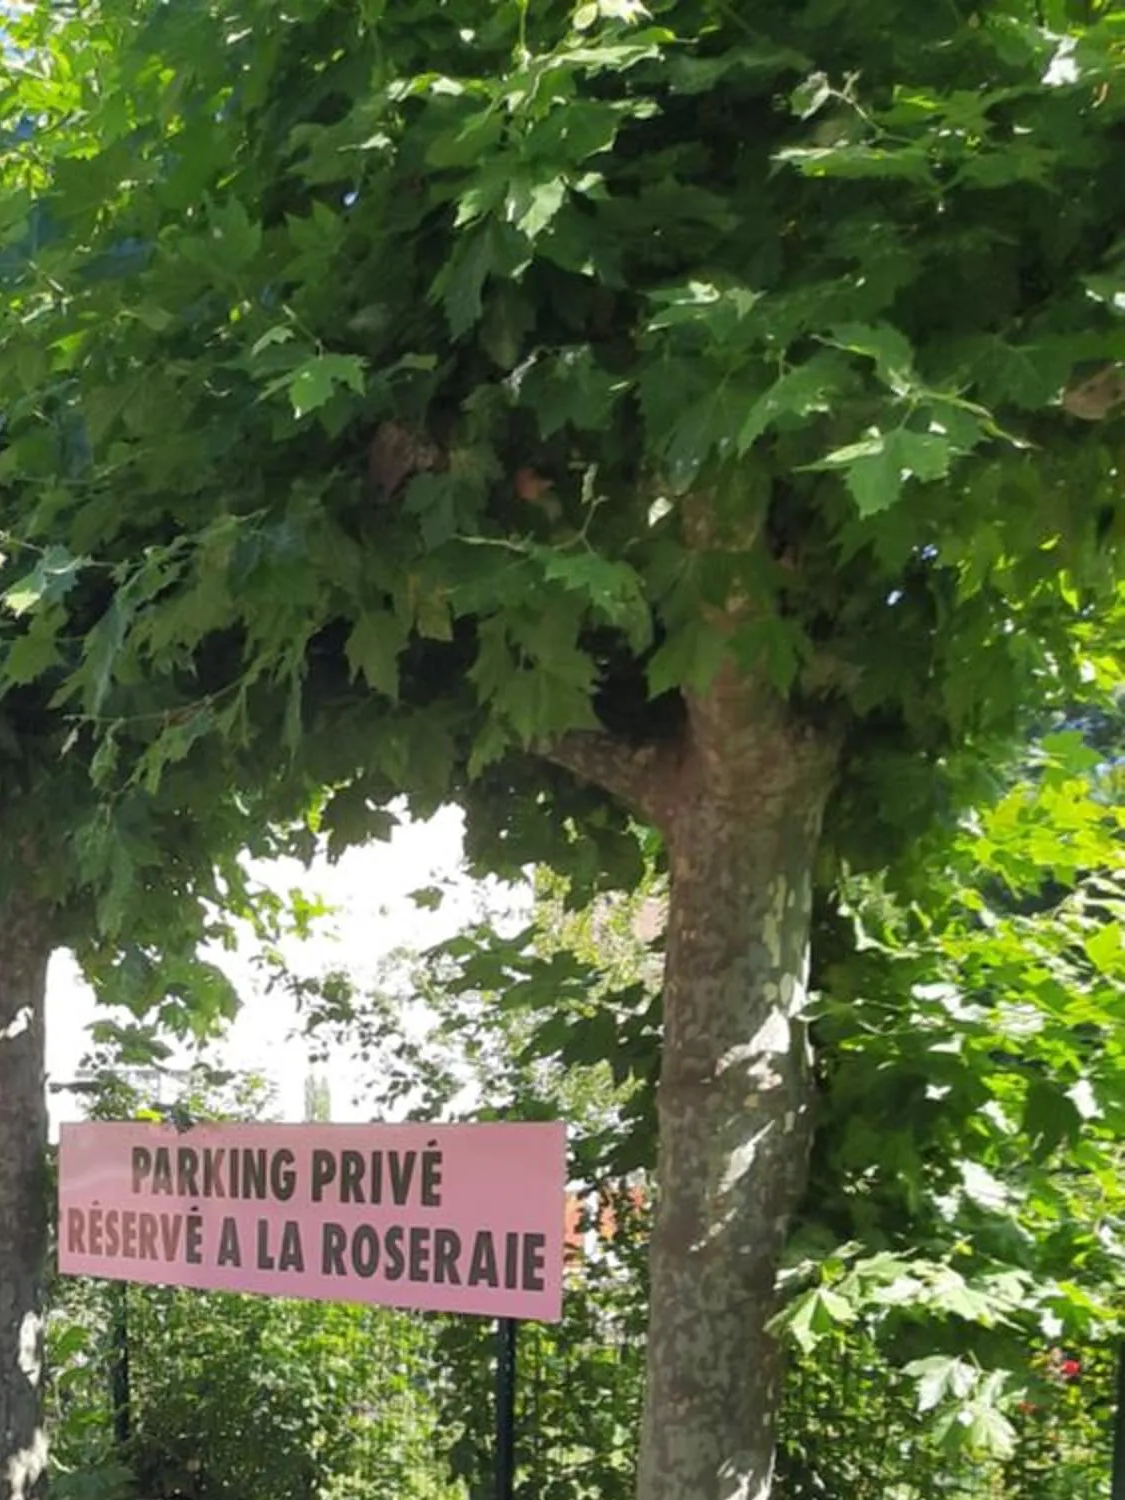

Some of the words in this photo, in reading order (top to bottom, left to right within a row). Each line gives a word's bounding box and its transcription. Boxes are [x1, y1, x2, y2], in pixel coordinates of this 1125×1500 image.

[131, 1145, 297, 1201] PARKING
[311, 1139, 443, 1207] PRIVÉ
[67, 1200, 203, 1265] RÉSERVÉ
[217, 1216, 242, 1267] A
[257, 1218, 305, 1273] LA
[321, 1222, 546, 1291] ROSERAIE
